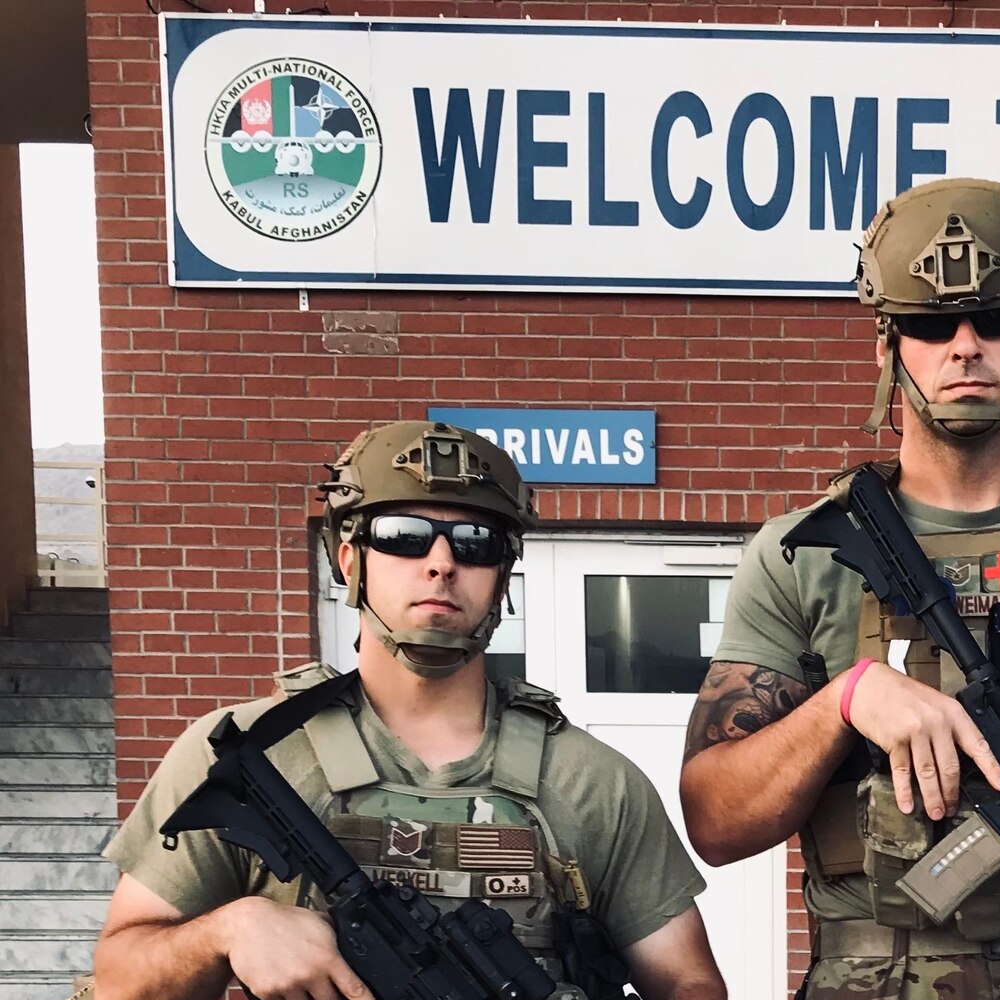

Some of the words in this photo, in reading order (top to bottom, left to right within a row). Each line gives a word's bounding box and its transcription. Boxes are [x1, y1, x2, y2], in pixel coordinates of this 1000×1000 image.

[210, 100, 232, 136] HKIA
[228, 63, 343, 99] MULTI-NATIONAL
[345, 90, 376, 137] FORCE
[413, 87, 950, 231] WELCOME
[283, 182, 309, 198] RS
[222, 190, 264, 230] KABUL
[270, 190, 367, 238] AFGHANISTAN
[475, 428, 645, 466] RIVALS
[507, 885, 527, 893] POS
